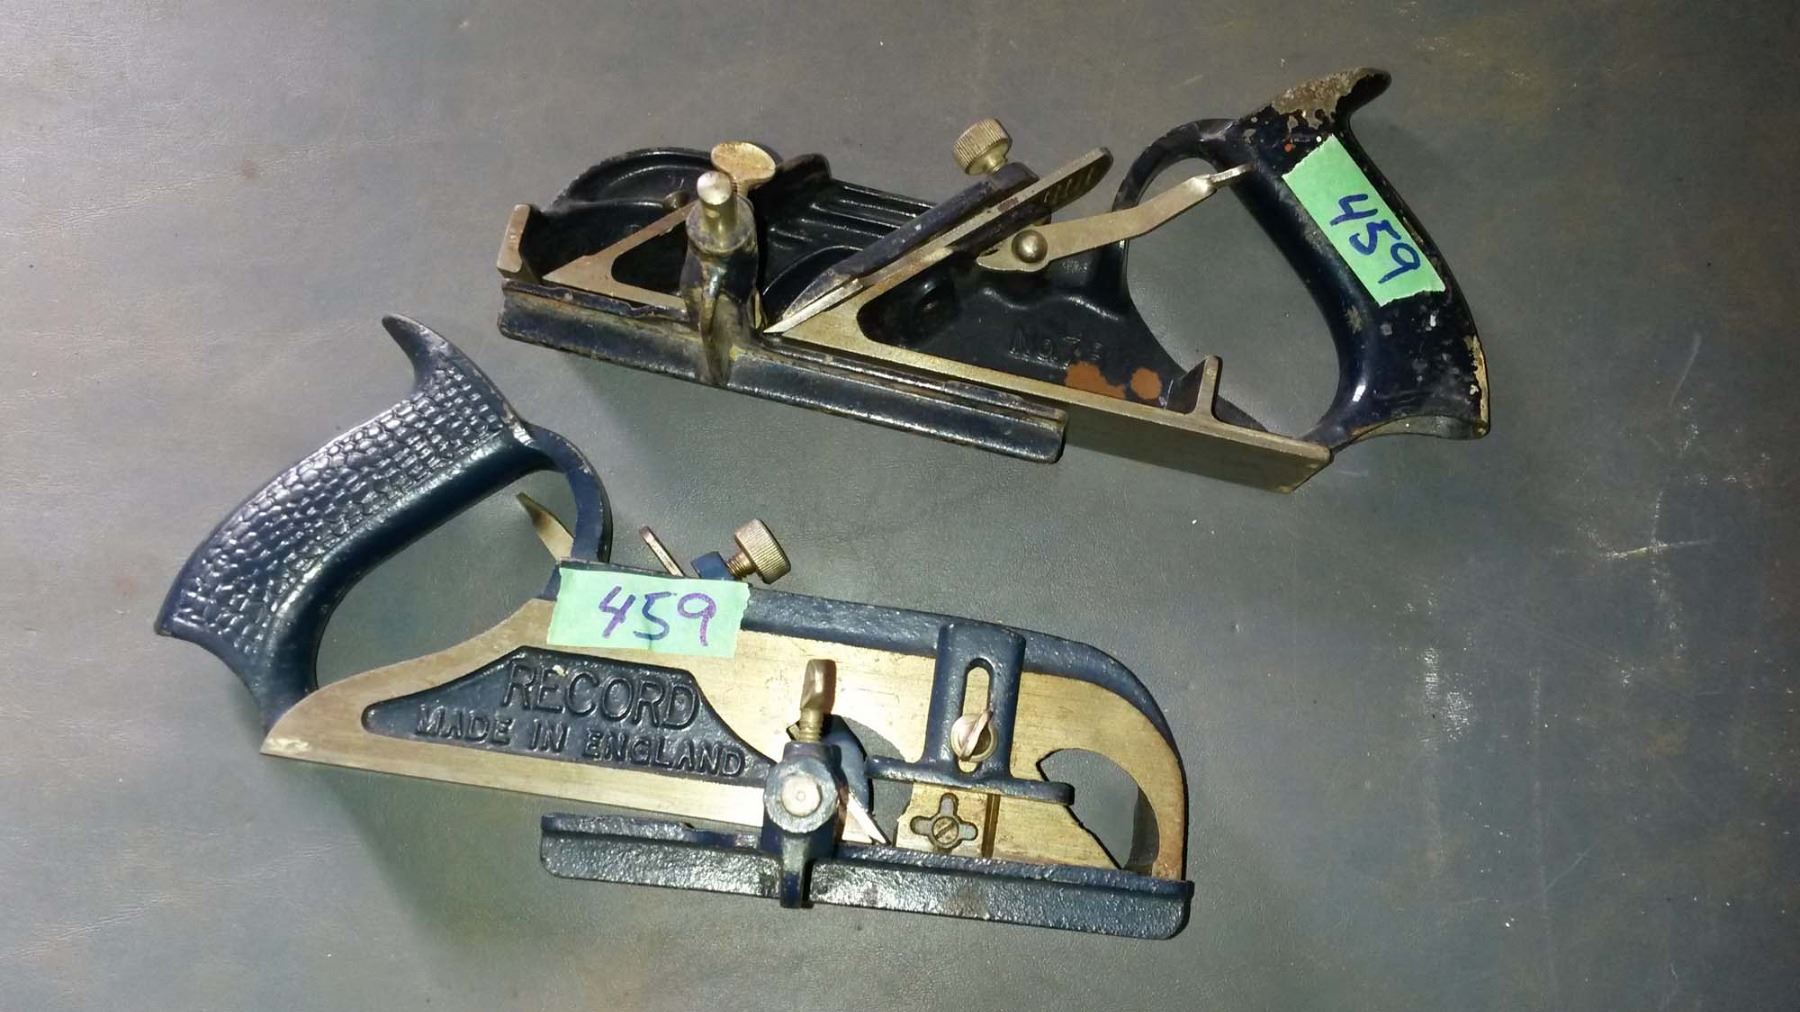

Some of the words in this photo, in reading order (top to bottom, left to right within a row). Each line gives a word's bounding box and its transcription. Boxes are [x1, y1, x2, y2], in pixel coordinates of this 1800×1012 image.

[1329, 193, 1421, 284] 459
[598, 585, 717, 647] 459
[503, 659, 700, 730] RECORD
[415, 705, 514, 743] MADE
[528, 719, 572, 752] IN
[586, 730, 747, 778] ENGLAND
